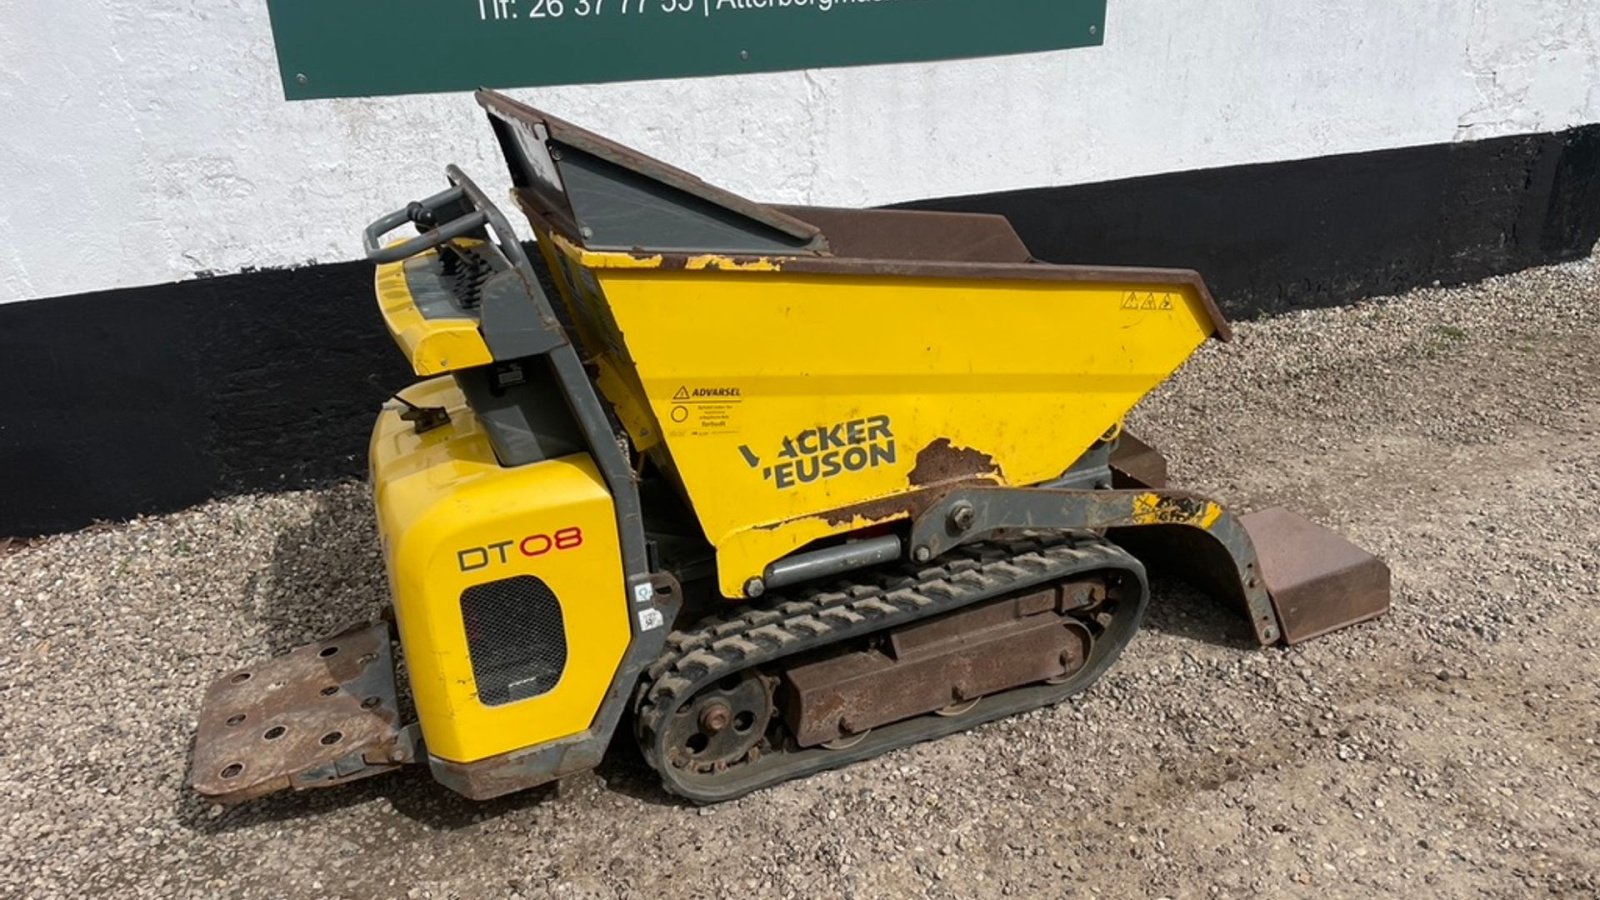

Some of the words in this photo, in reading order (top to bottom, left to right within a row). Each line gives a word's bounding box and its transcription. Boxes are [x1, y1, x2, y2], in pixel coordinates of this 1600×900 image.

[529, 0, 564, 18] 26
[574, 0, 605, 16] 37
[692, 388, 741, 397] ADVARSEL
[738, 414, 894, 468] ACKER
[763, 440, 895, 489] EUSON
